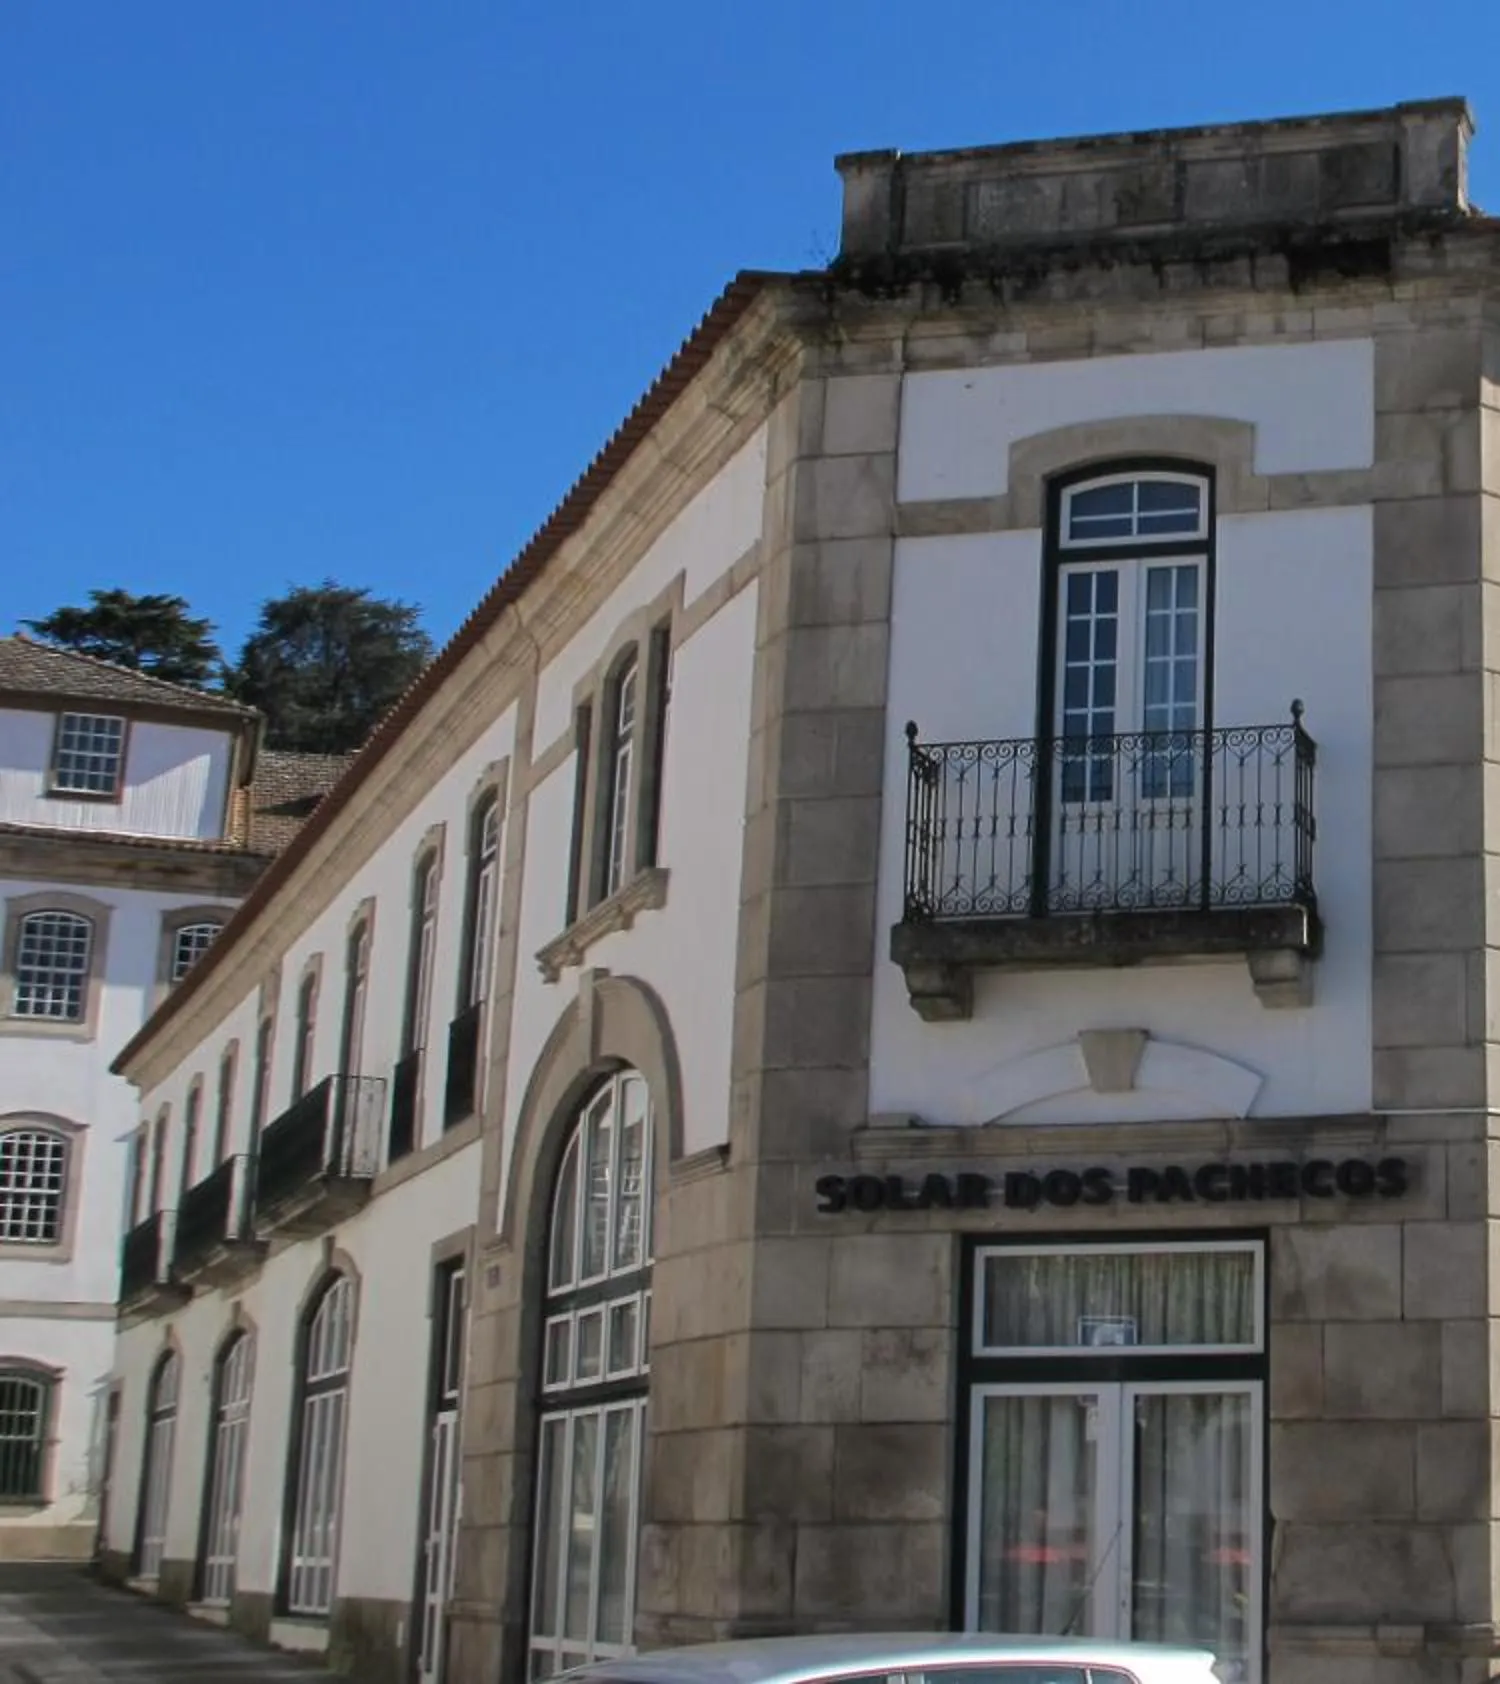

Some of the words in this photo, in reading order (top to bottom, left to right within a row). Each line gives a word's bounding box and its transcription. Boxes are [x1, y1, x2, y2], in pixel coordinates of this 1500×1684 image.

[815, 1173, 992, 1213] SOLAR
[1004, 1167, 1115, 1208] DOS
[1127, 1157, 1407, 1204] PACHECOS
